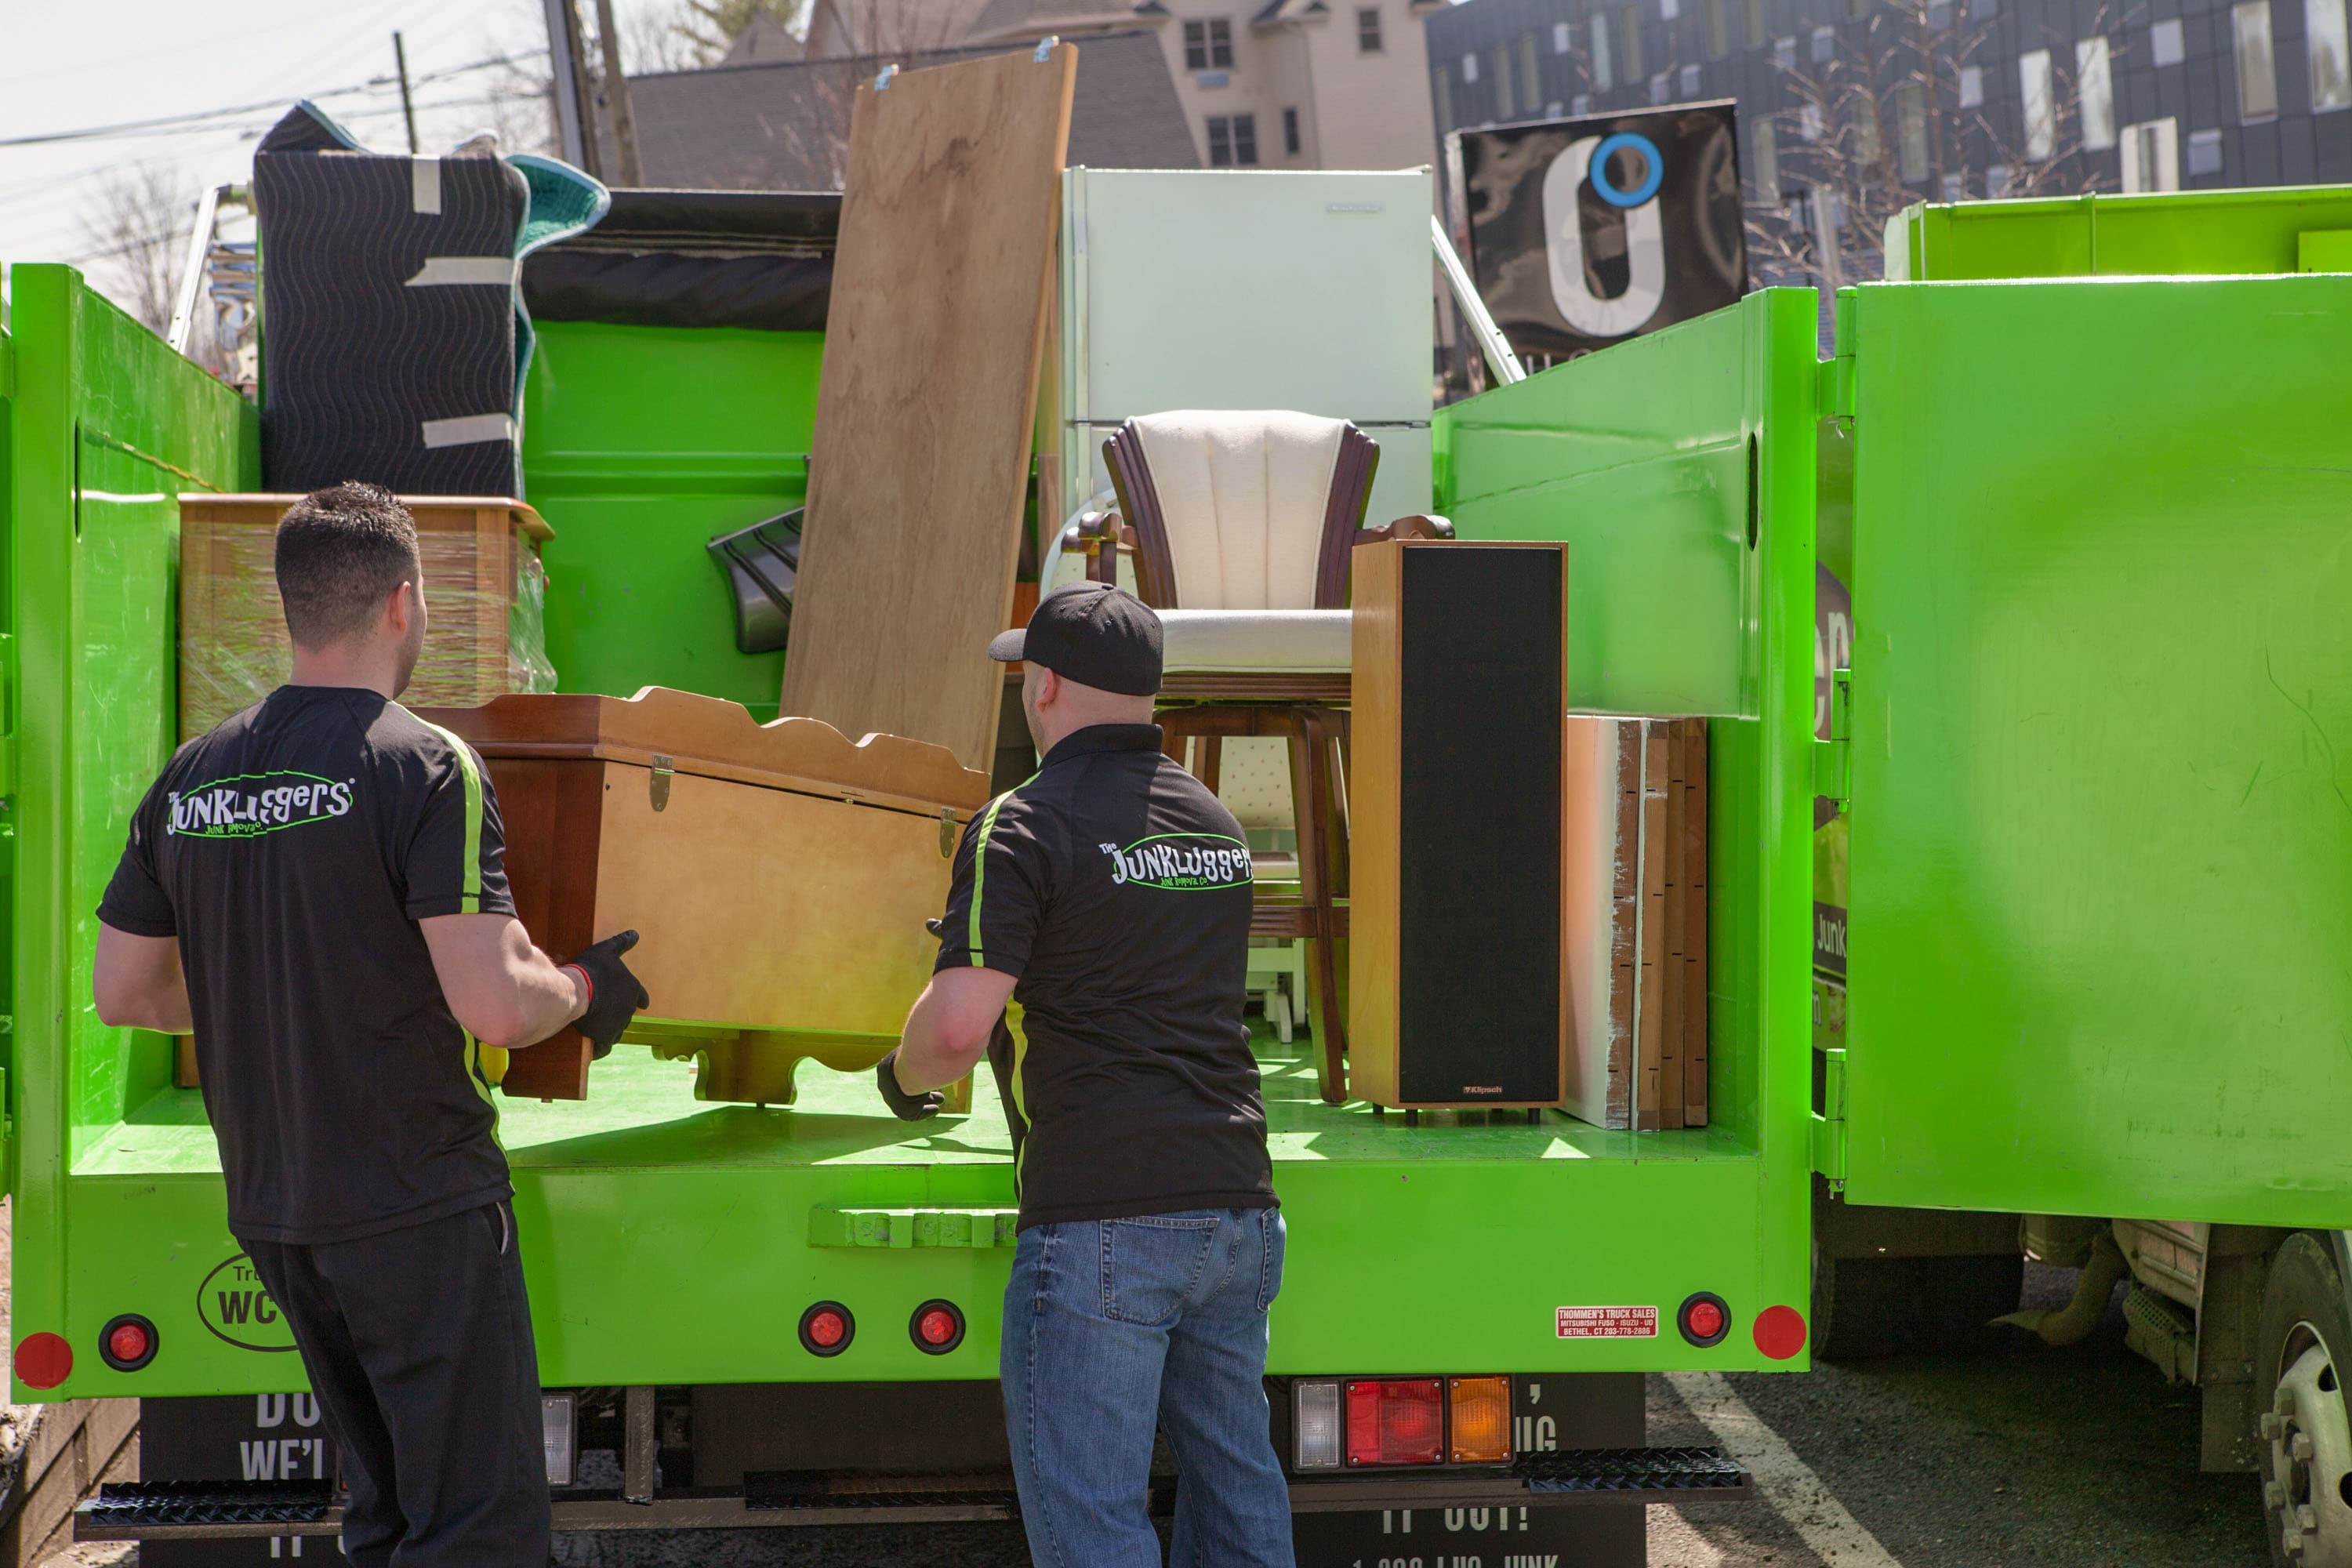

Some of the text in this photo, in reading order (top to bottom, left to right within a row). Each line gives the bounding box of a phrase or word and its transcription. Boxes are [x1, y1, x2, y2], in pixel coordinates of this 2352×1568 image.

[205, 825, 224, 835] JUNK
[1160, 877, 1174, 887] JUNK
[1817, 913, 1846, 958] Junk
[1471, 1086, 1502, 1094] Klipsch
[1559, 1308, 1655, 1319] THOMMEN'S TRUCK SALES
